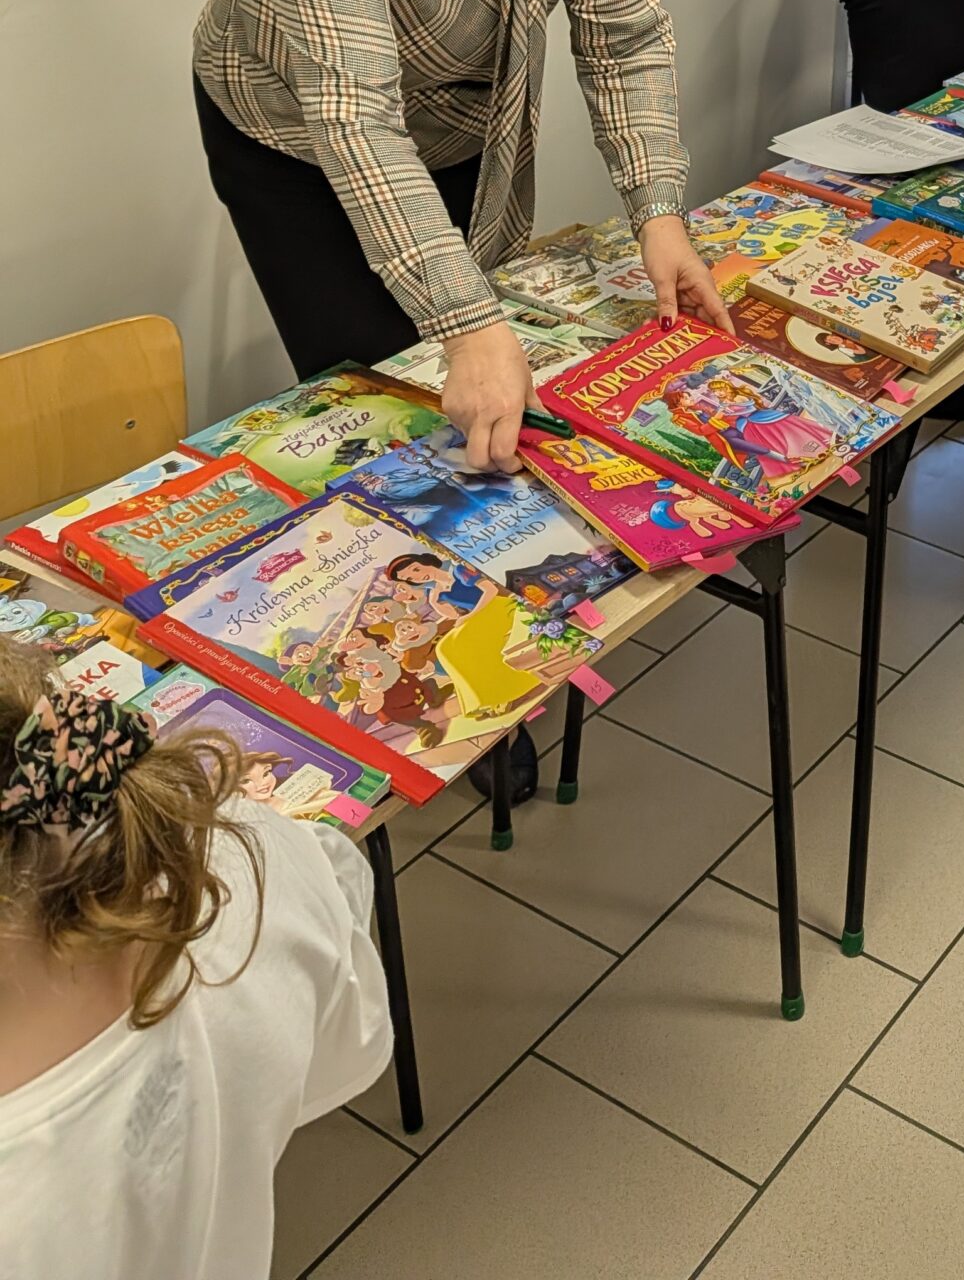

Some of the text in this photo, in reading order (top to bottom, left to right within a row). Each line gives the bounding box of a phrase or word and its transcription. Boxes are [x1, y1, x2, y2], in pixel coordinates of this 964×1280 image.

[606, 268, 651, 291] RO
[810, 256, 880, 297] KSIĘGA
[840, 274, 881, 298] 365
[846, 275, 904, 309] bajek
[570, 325, 713, 409] KOPCIUSZEK
[277, 411, 375, 458] Baśnie
[129, 492, 240, 540] Wielka
[156, 507, 249, 552] księga
[10, 542, 31, 557] Polskie
[472, 520, 547, 564] LEGEND
[226, 528, 383, 636] Królewna Śnieżka
[267, 549, 378, 629] i ukryty podarunek
[163, 621, 198, 648] Opowieści
[200, 644, 246, 676] prawdziwych
[246, 671, 283, 696] skarbach
